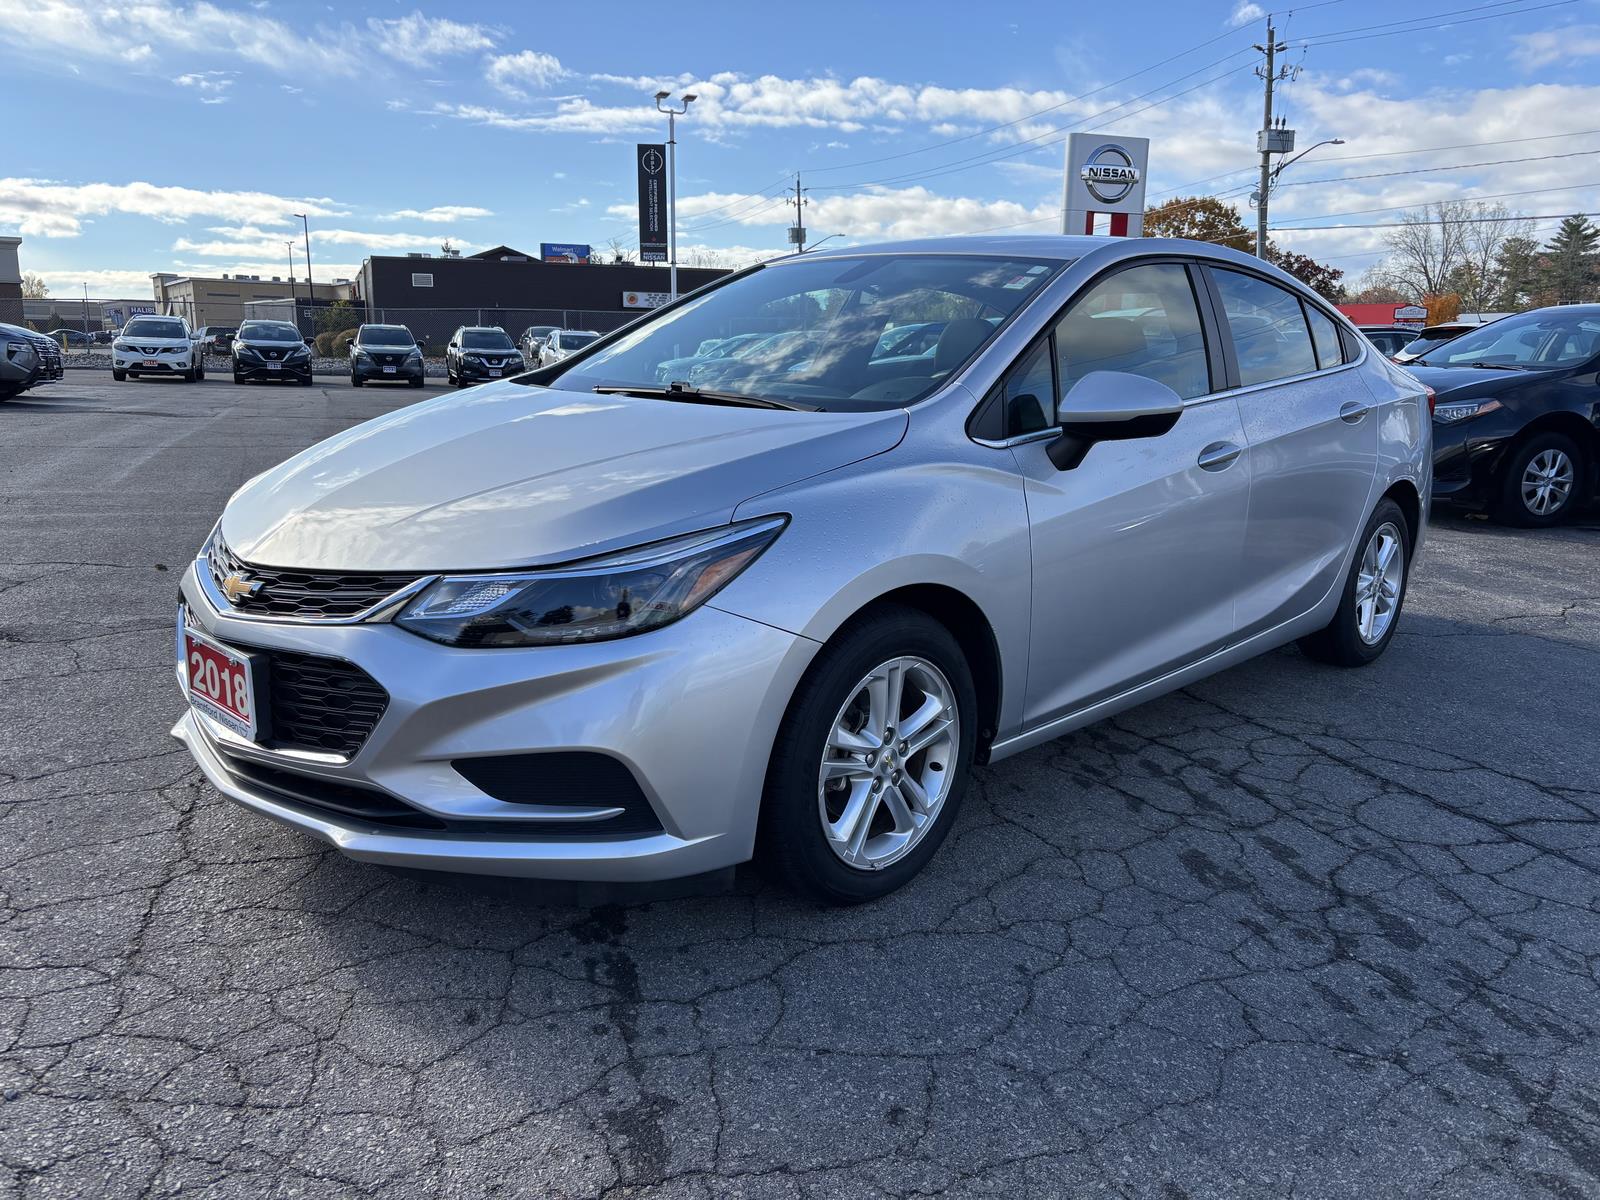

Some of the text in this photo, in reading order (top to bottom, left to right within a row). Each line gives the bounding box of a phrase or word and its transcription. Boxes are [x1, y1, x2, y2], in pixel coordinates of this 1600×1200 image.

[1088, 167, 1136, 179] NISSAN
[191, 651, 249, 717] 2018
[190, 695, 239, 732] Brantford Nissan
